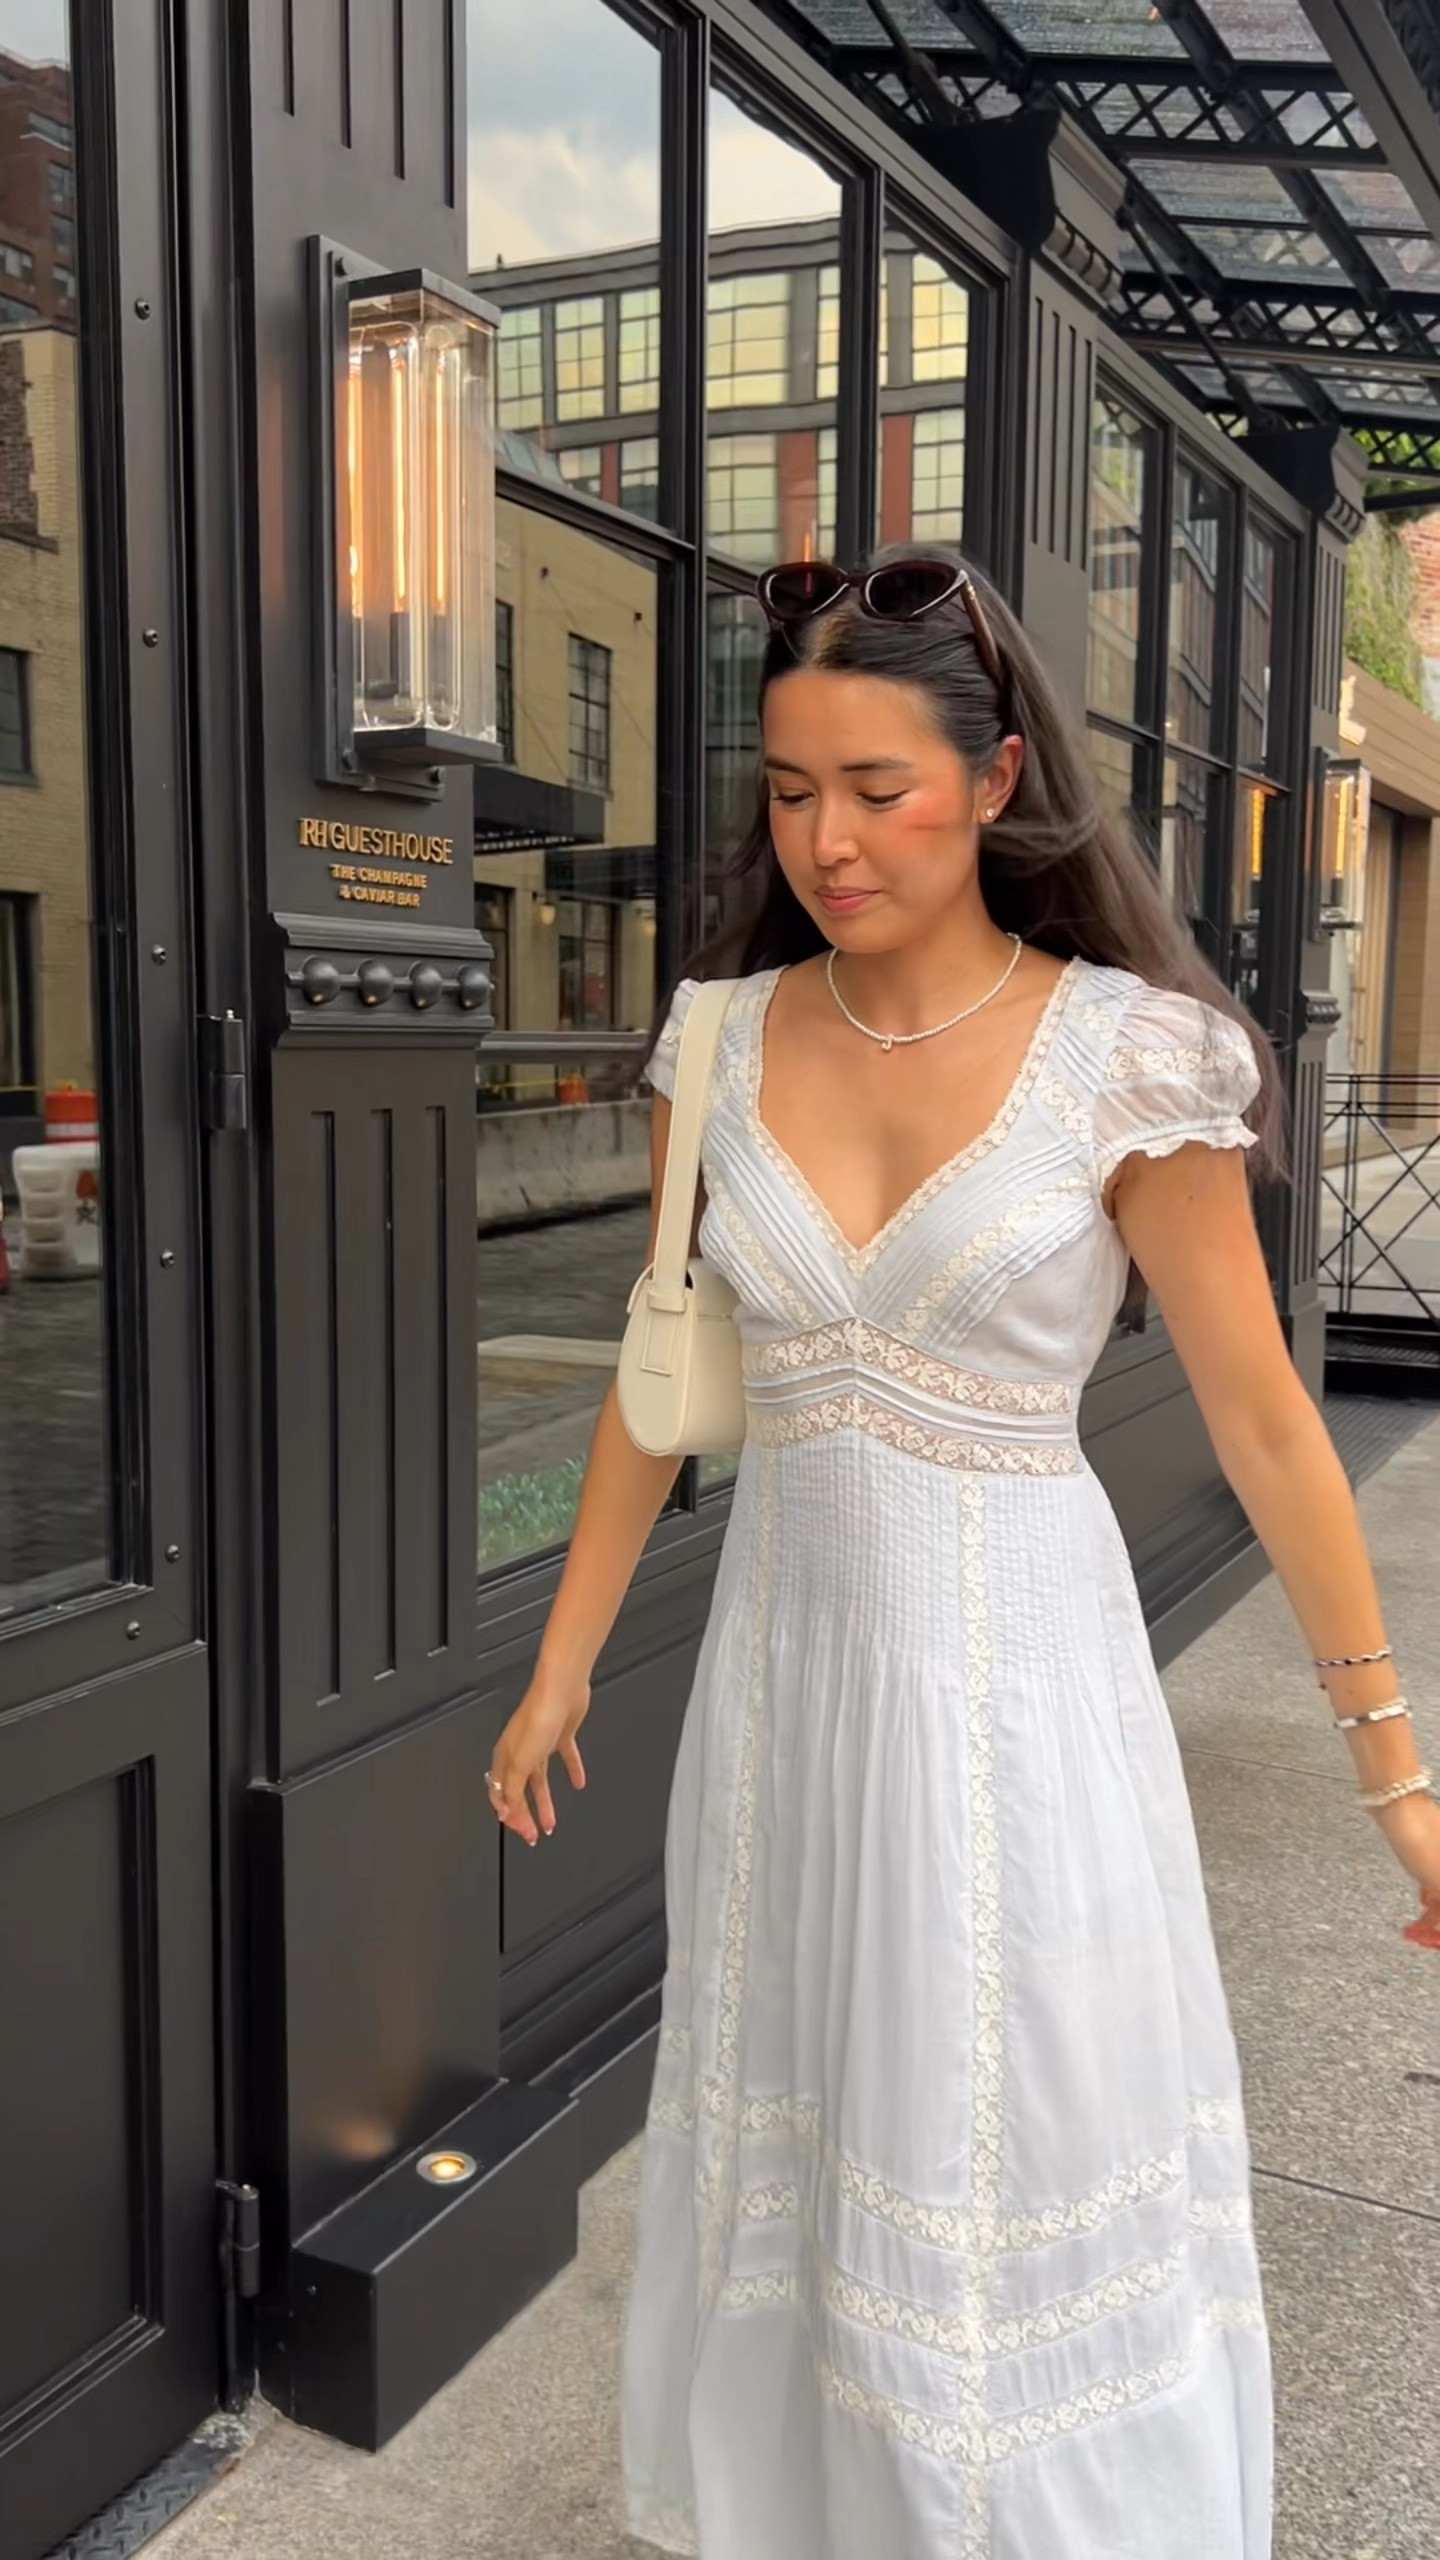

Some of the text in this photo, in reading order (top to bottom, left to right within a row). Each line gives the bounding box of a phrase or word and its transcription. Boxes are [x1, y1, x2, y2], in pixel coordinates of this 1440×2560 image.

[299, 817, 454, 864] RH GUESTHOUSE
[330, 864, 428, 888] THE CHAMPAGNE
[339, 884, 421, 907] & CAVIAR BAR
